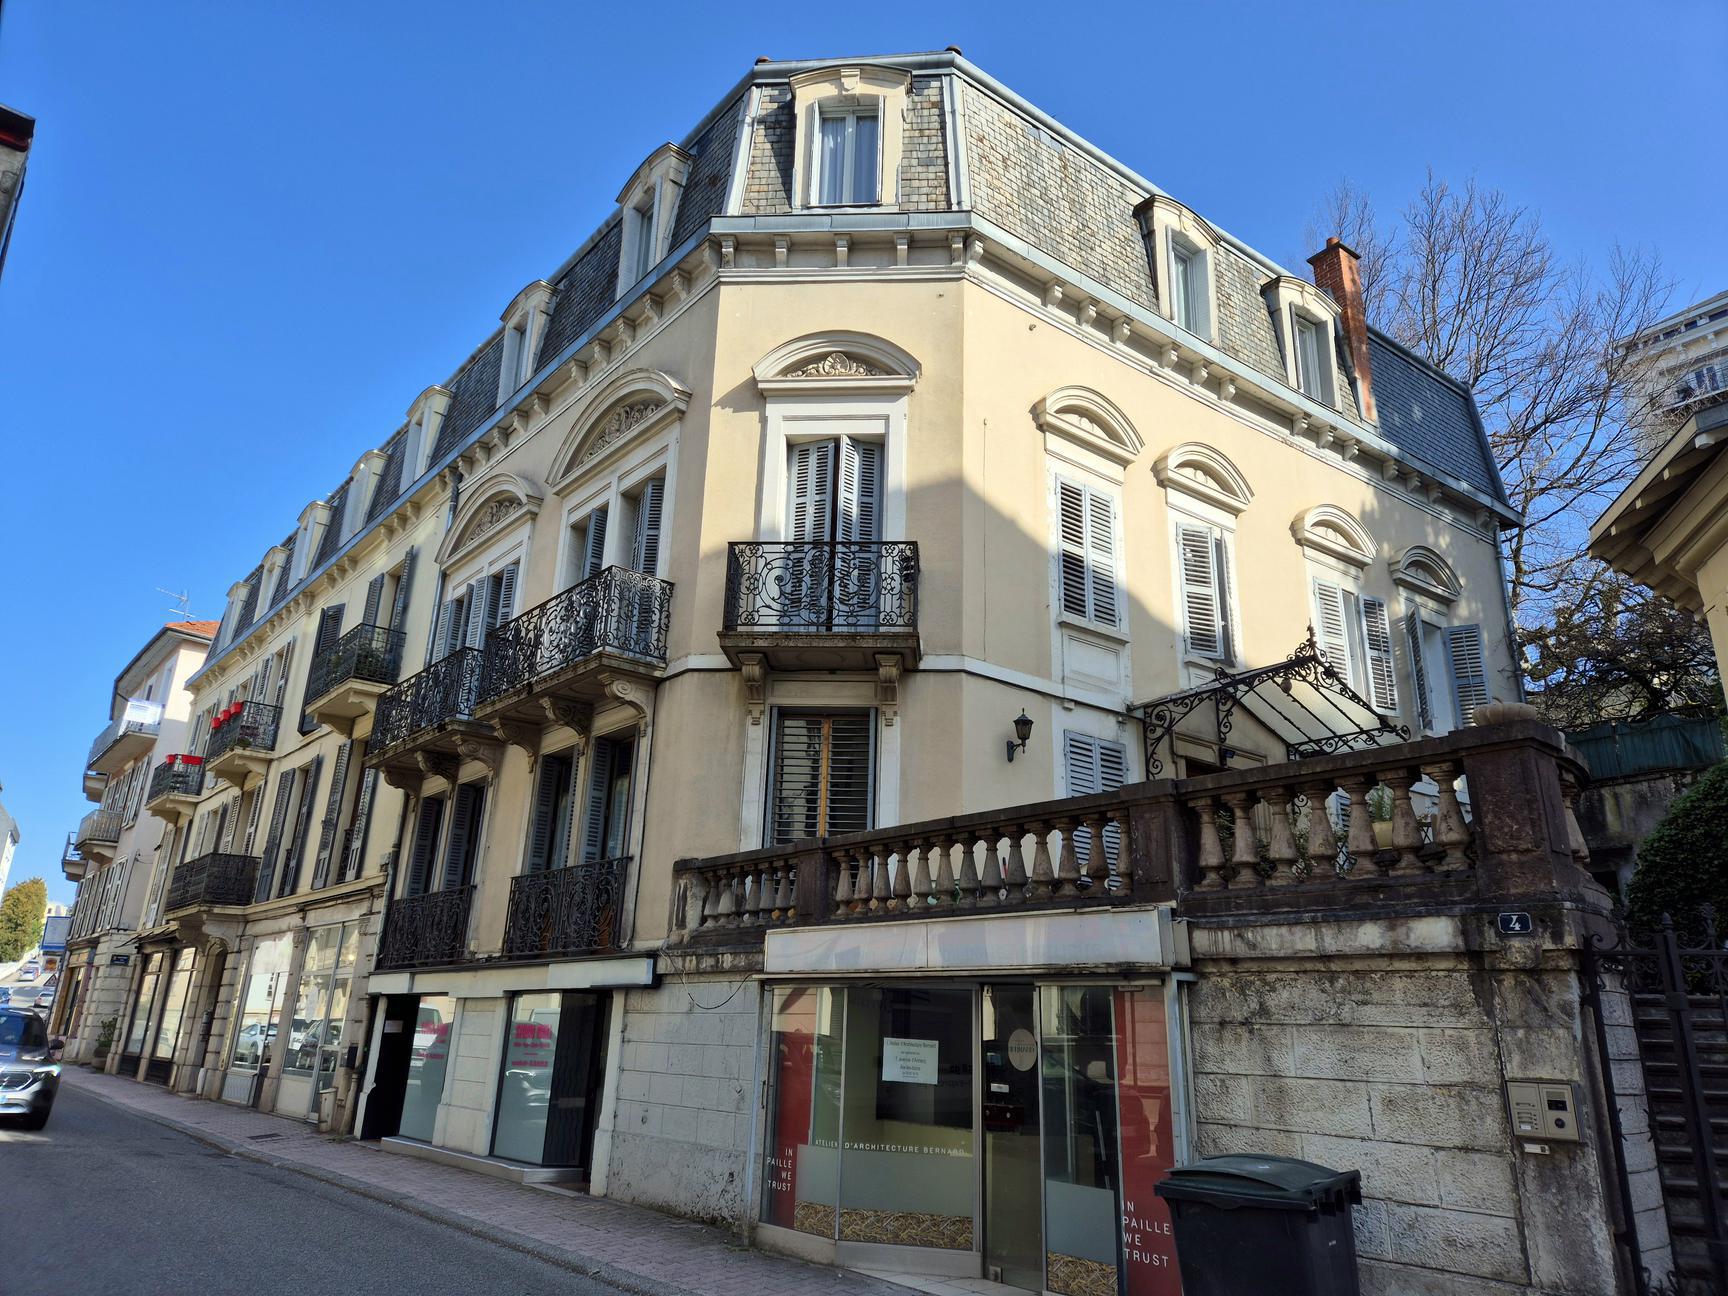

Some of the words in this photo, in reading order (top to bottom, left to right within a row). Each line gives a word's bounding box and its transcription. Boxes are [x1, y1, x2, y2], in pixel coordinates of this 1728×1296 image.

[1510, 915, 1521, 931] 4
[785, 1148, 793, 1157] IN
[815, 1139, 838, 1148] ATELIER
[844, 1142, 919, 1154] D'ARCHITECTURE
[923, 1146, 966, 1156] BERNARD
[766, 1156, 792, 1169] PAILLE
[781, 1171, 792, 1181] WE
[767, 1180, 791, 1192] TRUST
[1121, 1200, 1135, 1213] IN
[1122, 1216, 1171, 1235] PAILLE
[1123, 1231, 1142, 1246] WE
[1123, 1248, 1169, 1268] TRUST
